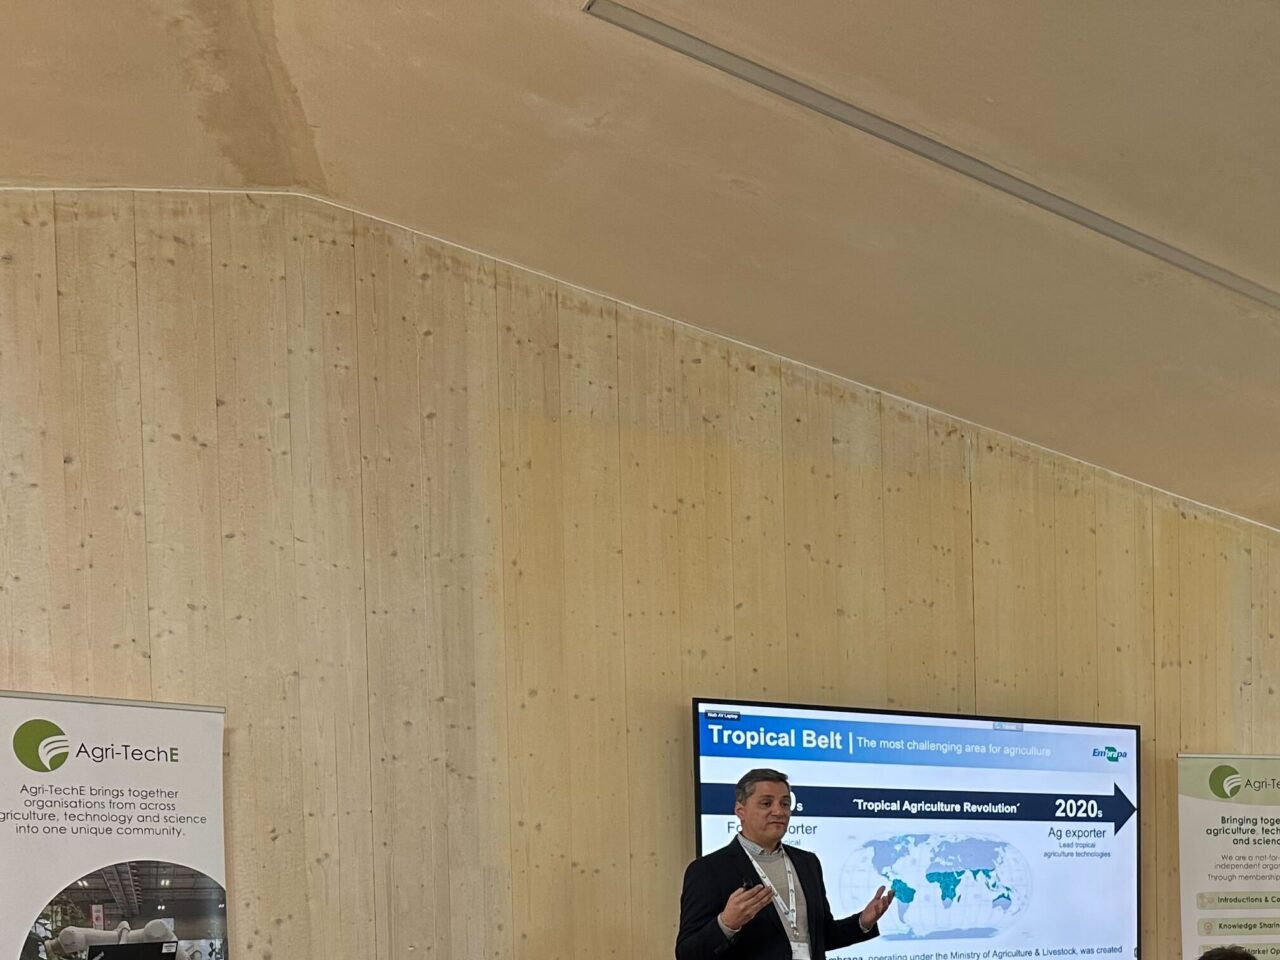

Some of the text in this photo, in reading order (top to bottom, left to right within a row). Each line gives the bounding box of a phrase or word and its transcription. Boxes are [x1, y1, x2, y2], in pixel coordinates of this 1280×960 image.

[708, 724, 842, 750] Tropical Belt
[75, 742, 179, 763] Agri-TechE
[856, 737, 1051, 757] The most challenging area for agriculture
[20, 784, 178, 800] Agri-TechE brings together
[24, 798, 176, 811] organisations from across
[902, 800, 961, 814] Agriculture
[1055, 798, 1103, 818] 2020s
[0, 810, 207, 824] griculture, technology and science
[1220, 816, 1258, 826] Bringing
[16, 824, 186, 838] into one unique community.
[788, 824, 818, 835] orter
[1048, 827, 1106, 840] Ag exporter
[1075, 842, 1096, 850] tropical
[1232, 837, 1250, 845] and
[1208, 874, 1236, 882] Through
[1238, 874, 1280, 882] membership
[1218, 896, 1262, 904] Introductions
[1218, 922, 1257, 930] Knowledge
[935, 952, 948, 960] the
[982, 950, 990, 958] of
[992, 948, 1032, 960] Agriculture
[1034, 948, 1040, 956] &
[1096, 946, 1122, 954] created
